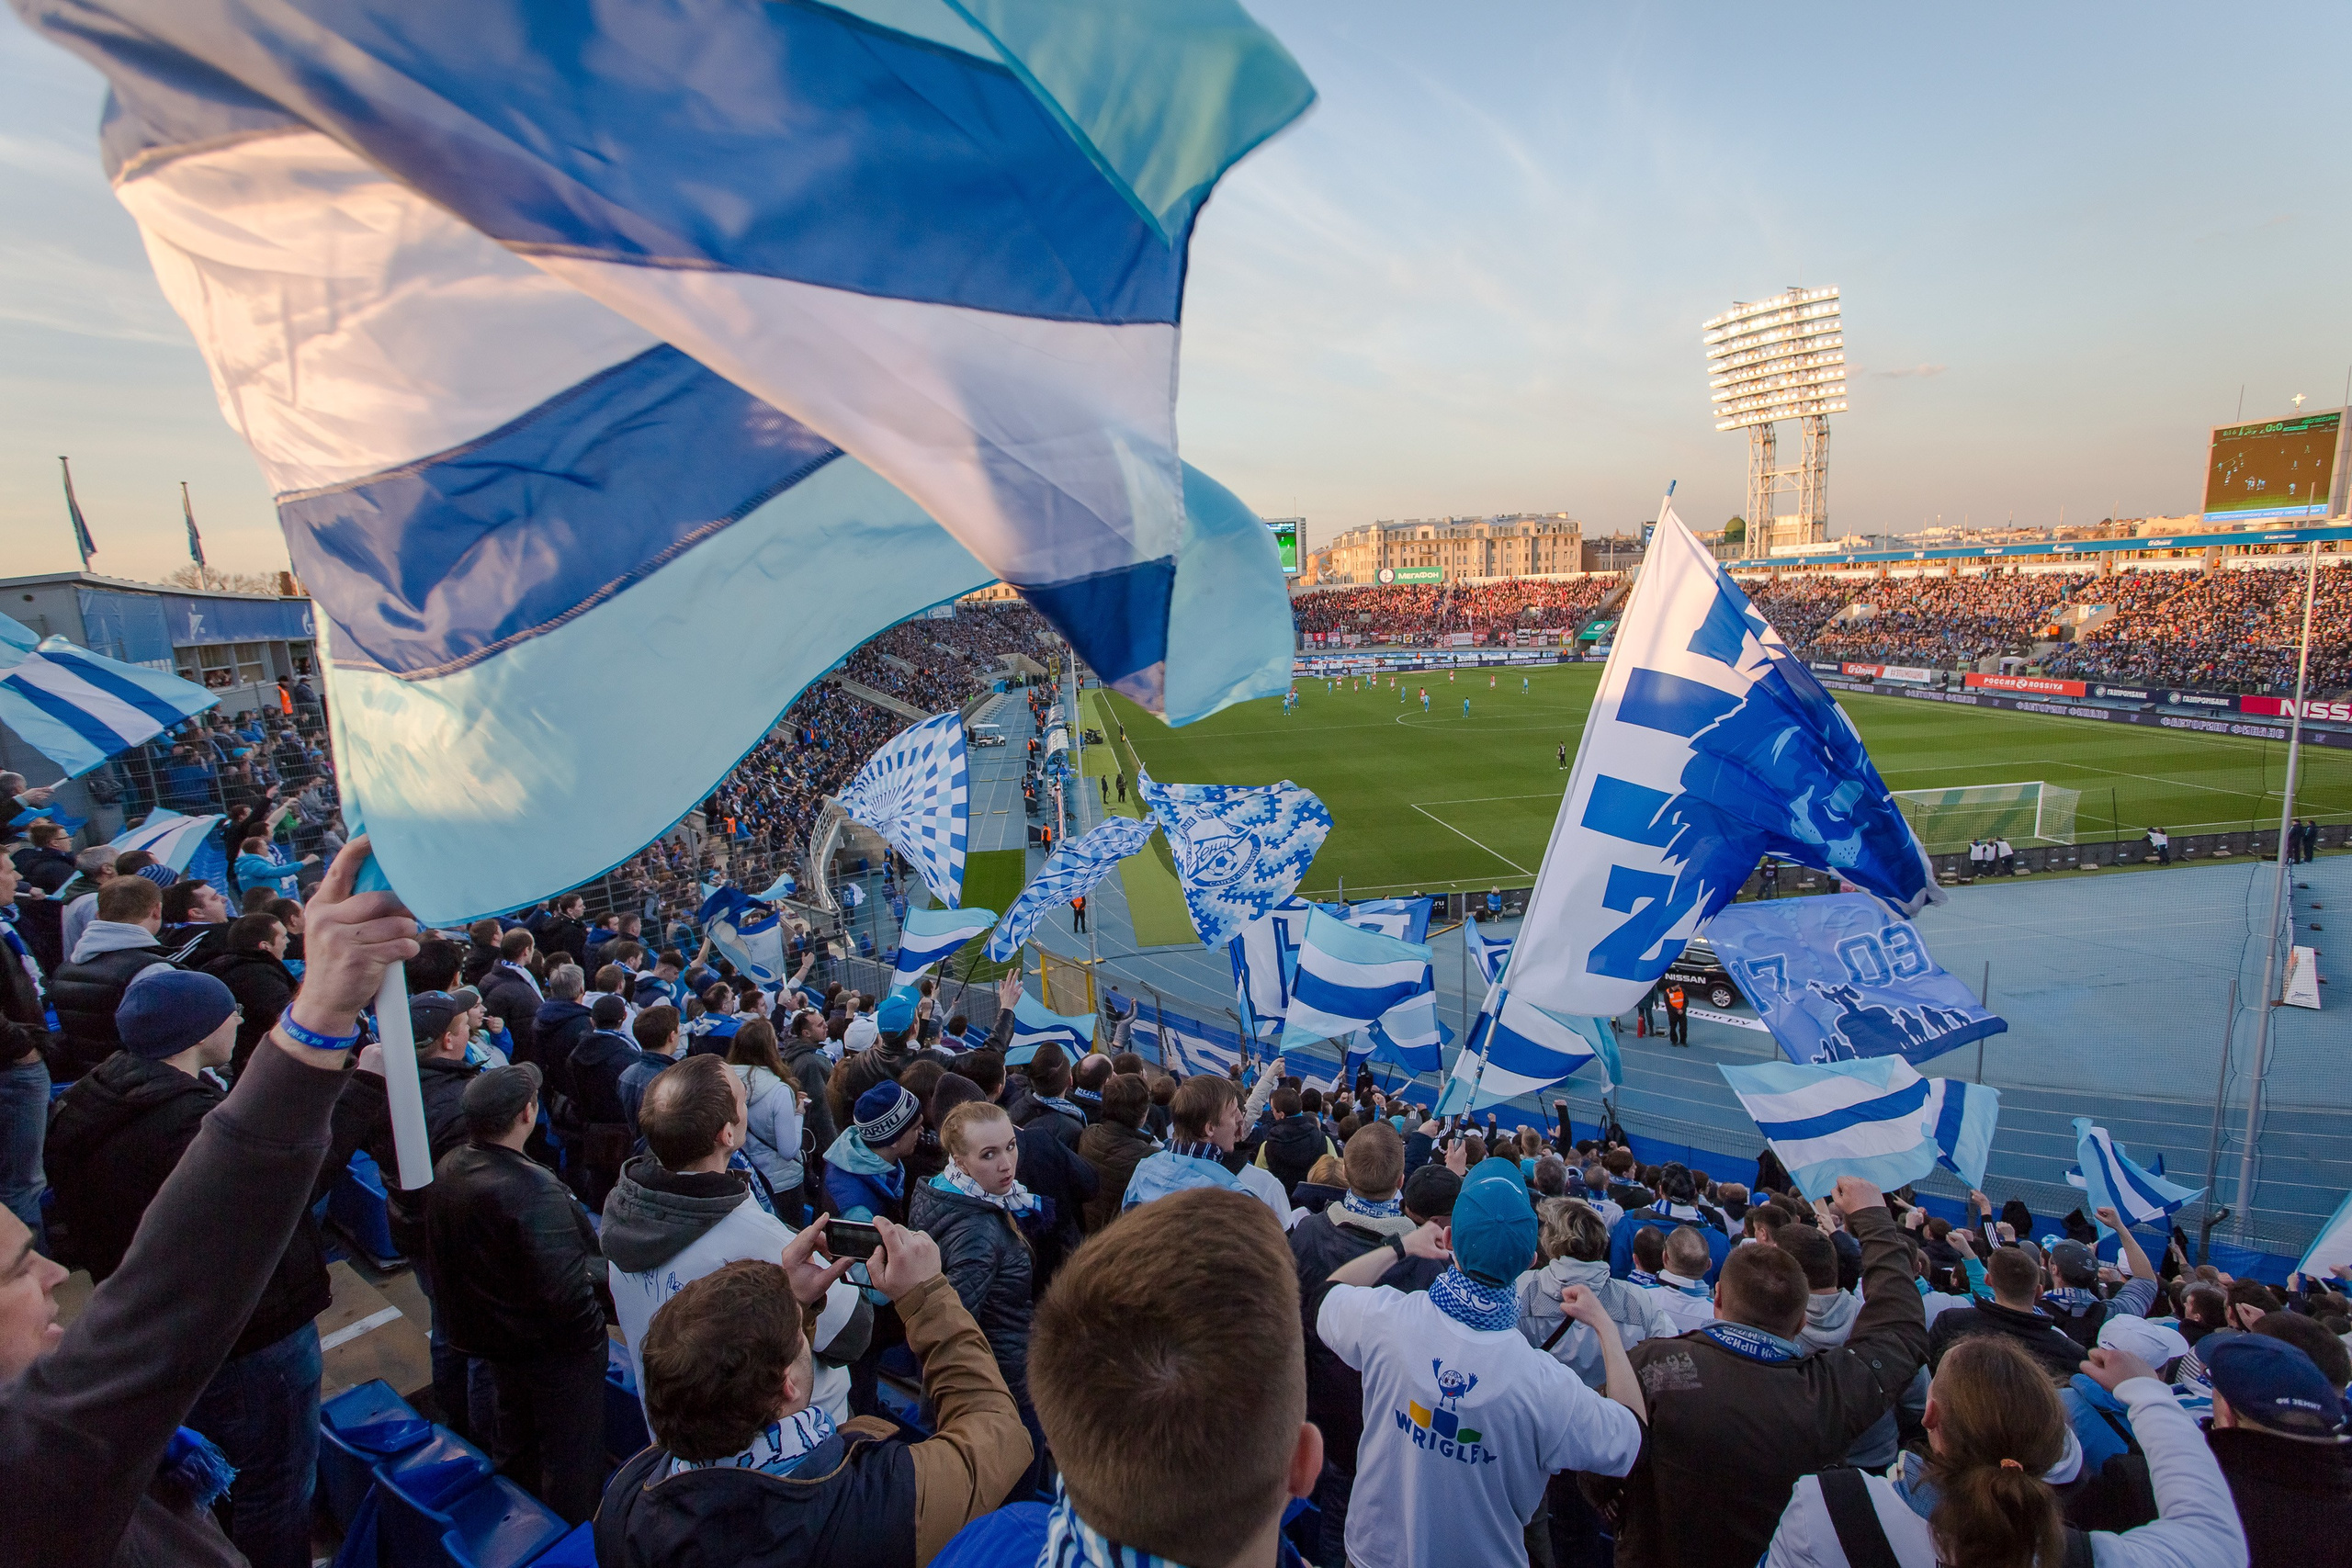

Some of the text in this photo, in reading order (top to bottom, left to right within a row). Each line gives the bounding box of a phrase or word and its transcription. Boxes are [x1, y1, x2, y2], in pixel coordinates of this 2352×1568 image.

[2265, 423, 2283, 433] 0:0
[1984, 677, 2015, 686] РОССИЯ
[2029, 680, 2064, 690] ROSSIYA
[2107, 689, 2148, 699] ГАЗПРОМБАНК
[2182, 695, 2230, 706] ГАЗПРОМБАНК
[2279, 699, 2352, 722] NISS
[2160, 716, 2285, 739] ФАКТОРИНГ ФИНАНС
[1665, 973, 1707, 985] NISSAN
[1395, 1408, 1498, 1465] WRIGLEY
